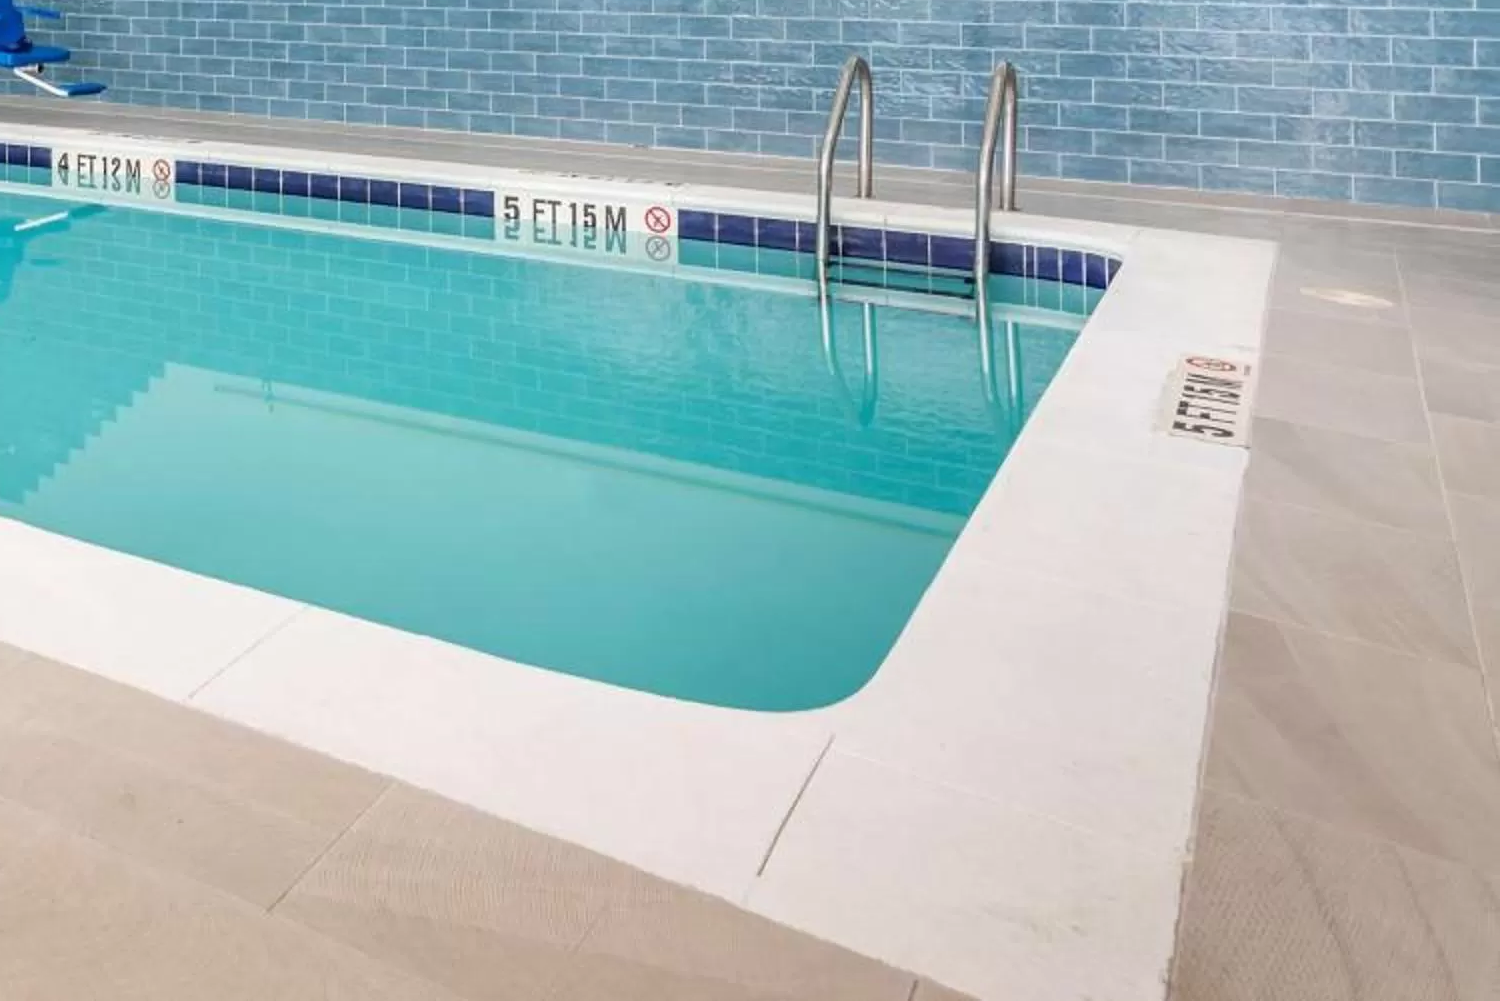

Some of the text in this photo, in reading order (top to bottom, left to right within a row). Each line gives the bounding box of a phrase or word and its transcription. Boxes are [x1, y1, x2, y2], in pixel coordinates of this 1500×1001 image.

[58, 152, 69, 171] 4
[77, 154, 97, 175] FT
[504, 196, 520, 220] 5
[533, 198, 562, 225] FT
[1172, 420, 1235, 438] 5
